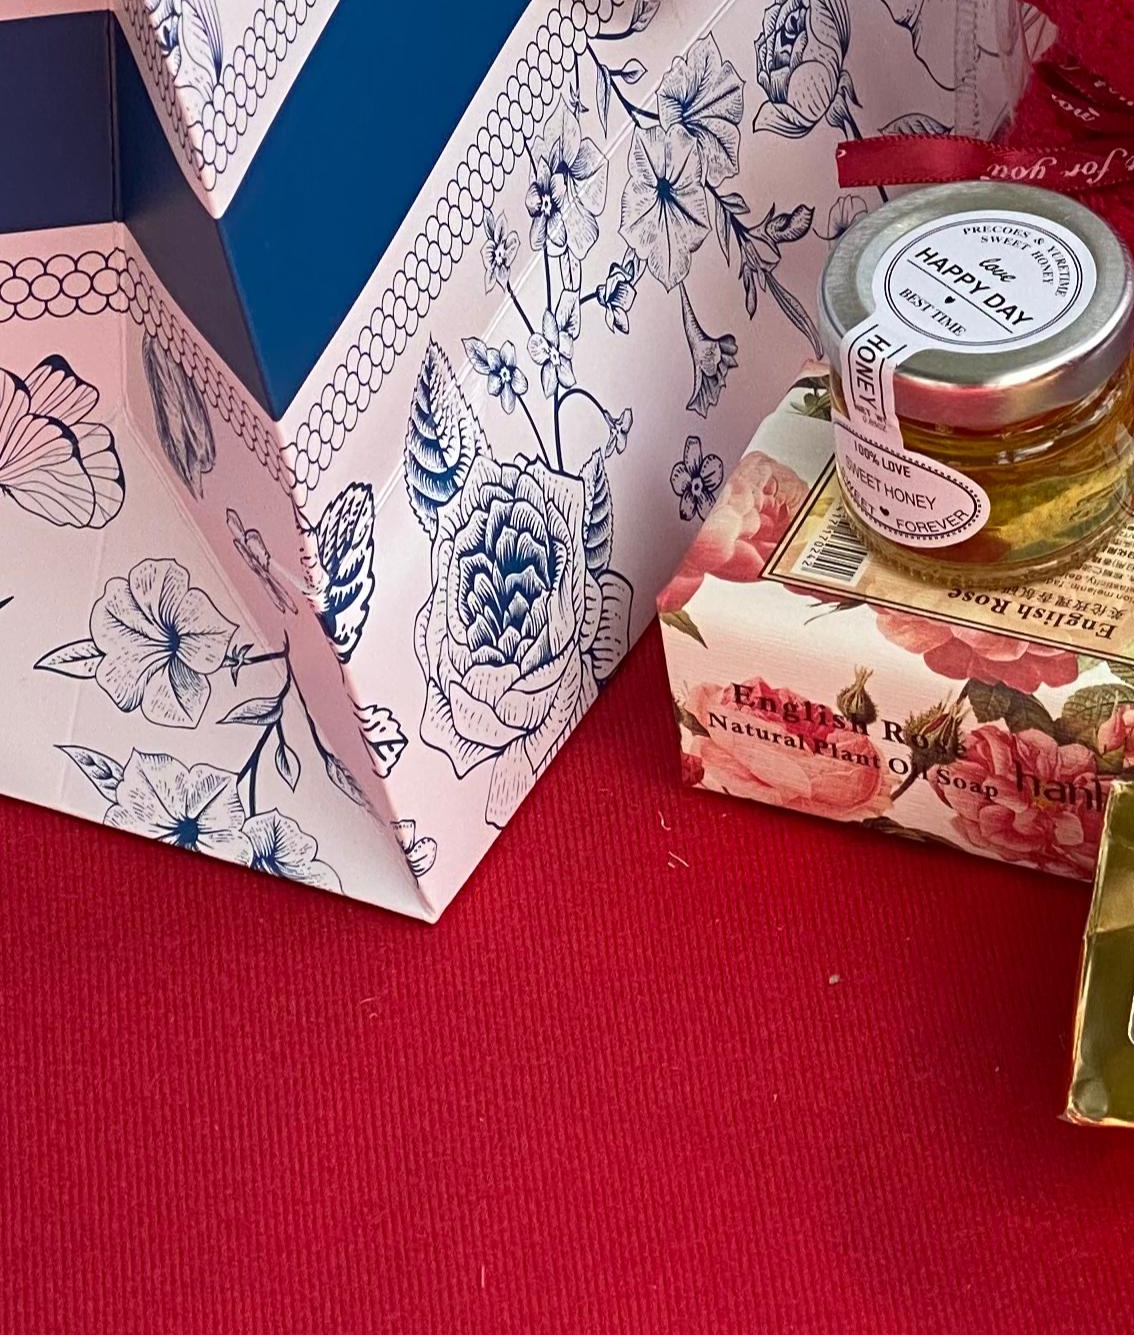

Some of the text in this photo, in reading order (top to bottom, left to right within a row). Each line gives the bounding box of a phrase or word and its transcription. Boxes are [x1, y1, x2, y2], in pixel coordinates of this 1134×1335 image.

[986, 156, 1058, 180] you
[1060, 148, 1128, 184] for
[979, 258, 1017, 283] love
[980, 235, 1054, 285] SWEET HONEY
[914, 247, 1034, 326] HAPPY DAY
[899, 288, 967, 337] BEST TIME
[857, 334, 892, 410] HONEY
[845, 454, 936, 511] SWEET HONEY
[854, 440, 911, 478] 100% LOVE
[896, 509, 969, 535] FOREVER
[947, 588, 1118, 640] English Rose
[732, 682, 869, 736] English
[708, 712, 805, 751] Natural
[814, 739, 880, 769] Plant
[936, 768, 998, 802] Soap
